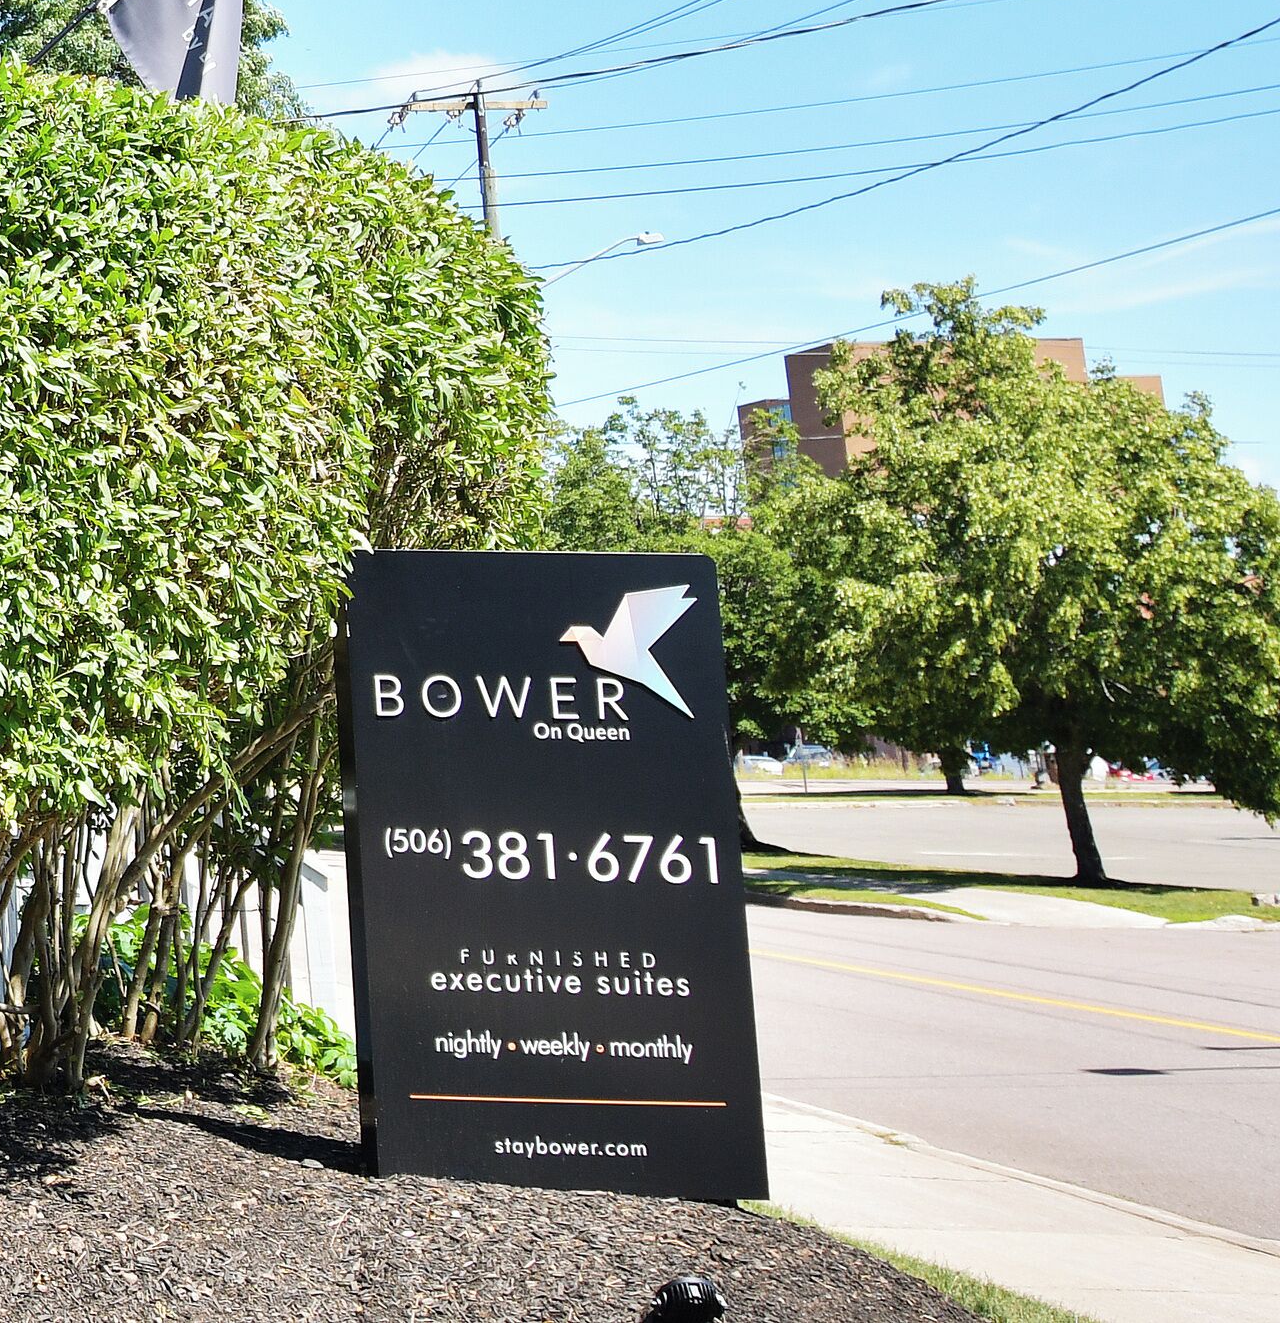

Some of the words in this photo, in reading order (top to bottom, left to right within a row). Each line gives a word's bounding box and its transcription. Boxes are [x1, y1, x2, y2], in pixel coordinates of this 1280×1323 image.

[373, 674, 630, 721] BOWER
[534, 722, 563, 740] On
[567, 723, 631, 743] Queen
[385, 827, 452, 860] (506)
[460, 948, 657, 970] FURNISHED
[430, 967, 582, 994] executive
[596, 970, 691, 997] suites
[434, 1029, 502, 1060] nightly
[520, 1031, 591, 1062] weekly
[609, 1034, 693, 1065] monthly
[494, 1135, 648, 1159] staybower.com
